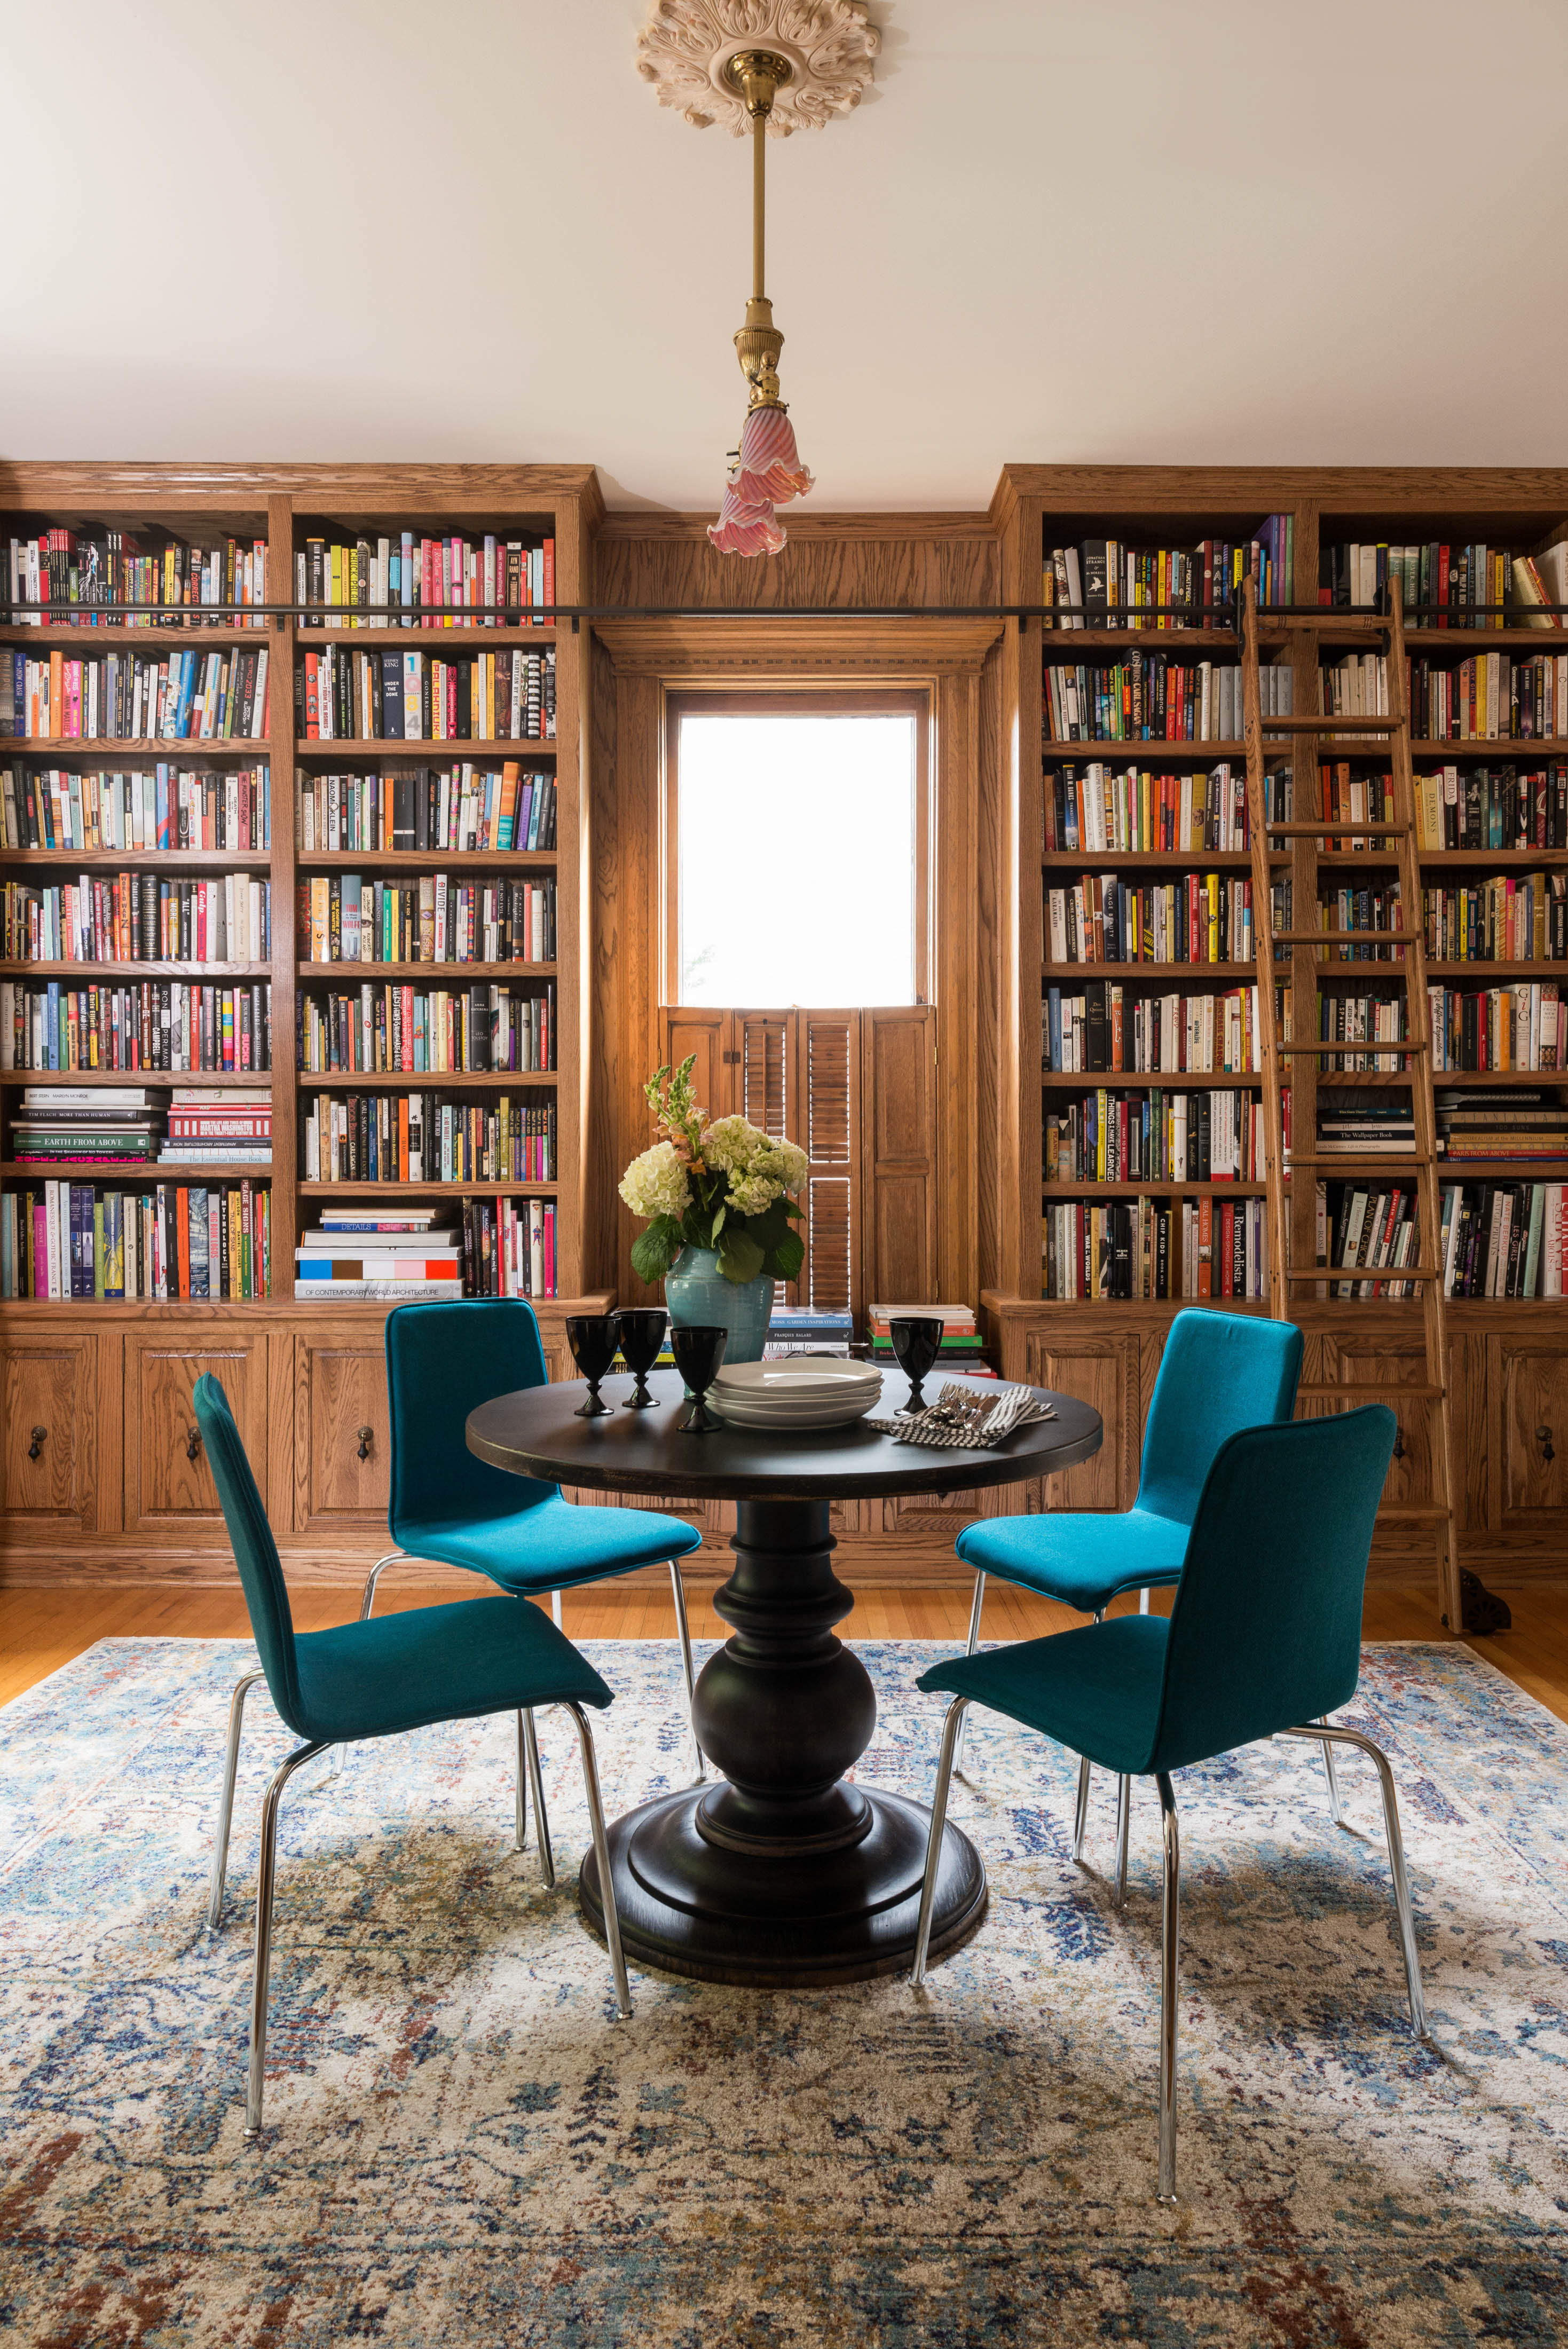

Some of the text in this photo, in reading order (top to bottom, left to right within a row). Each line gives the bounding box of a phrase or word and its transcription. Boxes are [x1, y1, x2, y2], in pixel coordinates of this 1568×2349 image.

[255, 558, 264, 582] JPod
[15, 667, 24, 696] SNOW CRASH
[294, 669, 302, 705] BLACKWATER
[432, 664, 440, 732] PALAHNIUK
[1133, 683, 1141, 724] CARL SAGAN
[1447, 773, 1455, 799] FRIDA
[1429, 793, 1437, 833] DEMONS
[198, 890, 207, 915] Gulp.
[437, 882, 446, 912] DIVIDE
[152, 1027, 161, 1055] CAMPBELL
[210, 1212, 218, 1259] BIG BOOK LOGOS
[230, 1226, 235, 1234] OF
[1501, 1224, 1509, 1256] BERKUS
[1233, 1216, 1244, 1282] Remodelista
